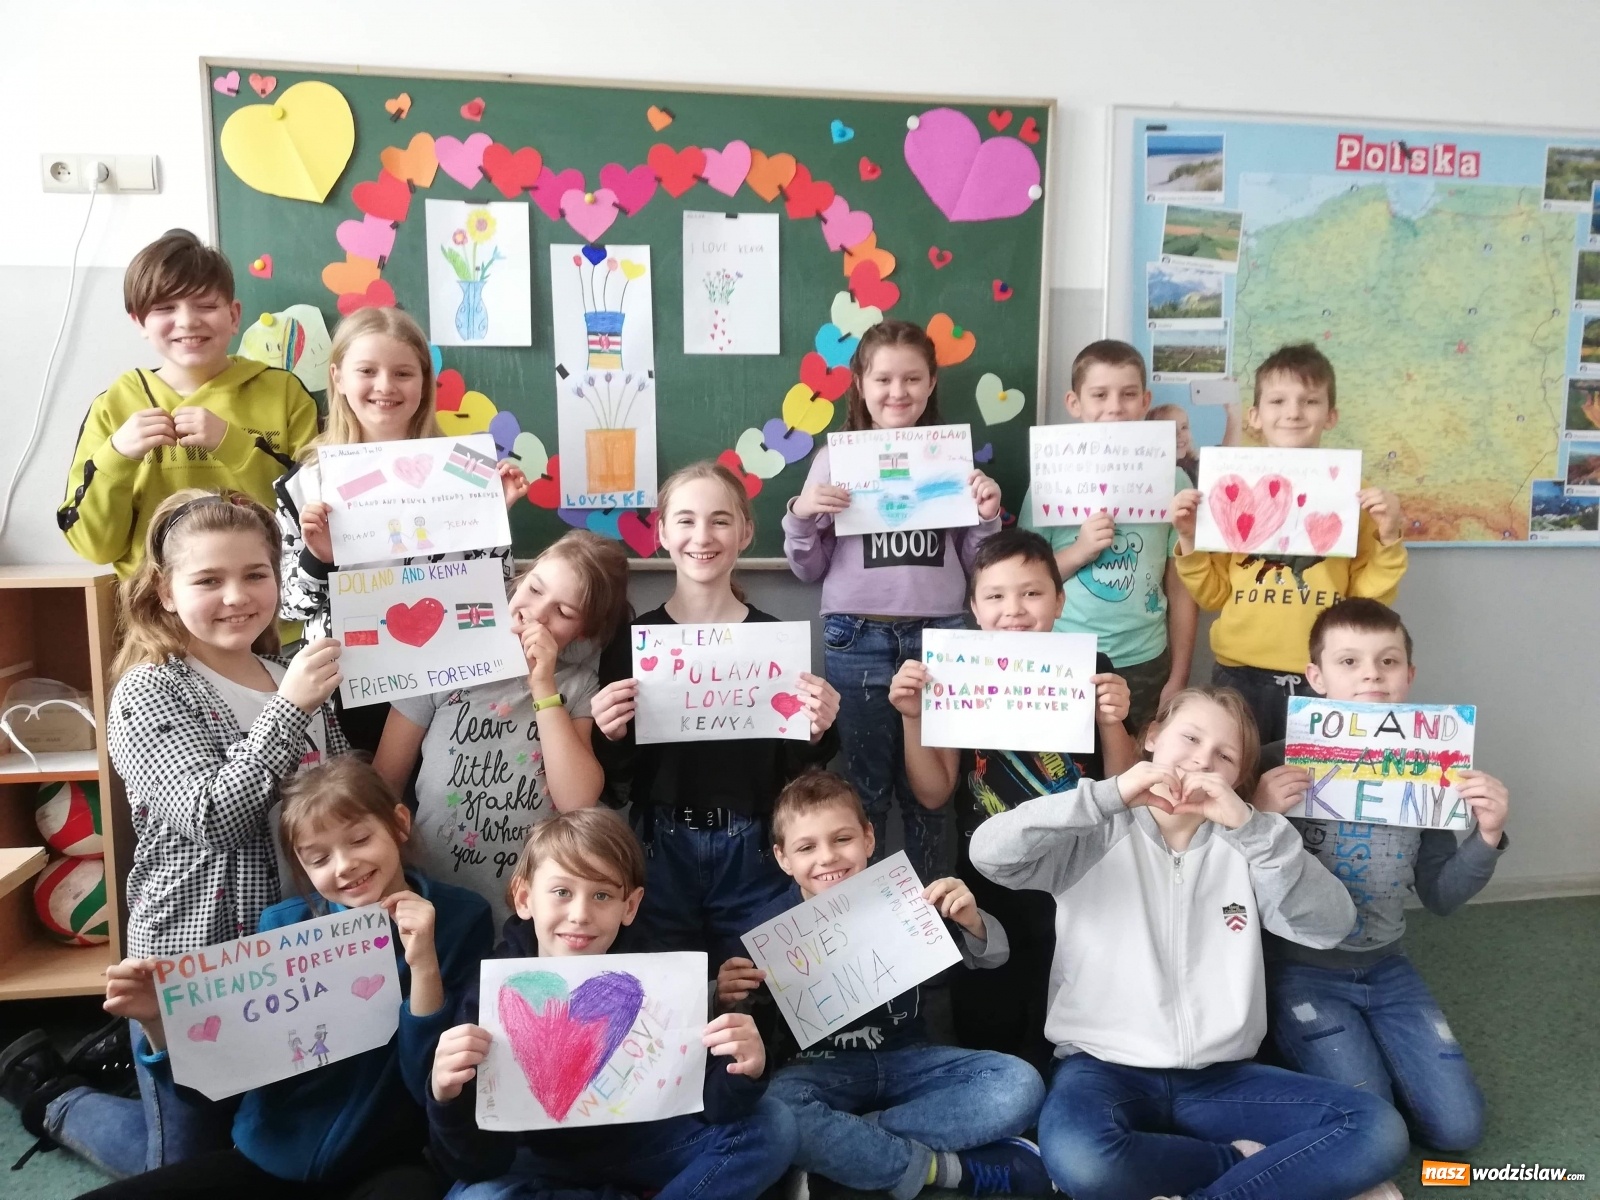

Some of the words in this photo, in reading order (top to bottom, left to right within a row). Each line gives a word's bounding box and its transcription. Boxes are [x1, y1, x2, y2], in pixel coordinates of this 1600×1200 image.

[1338, 137, 1478, 177] Polska
[739, 244, 764, 254] KENYA
[896, 431, 924, 441] FROM
[926, 429, 967, 441] POLAND
[1034, 441, 1101, 459] POLAND
[1103, 443, 1130, 456] AND
[343, 530, 376, 542] POLAND
[871, 530, 940, 559] MOOD
[338, 568, 394, 595] POLAND
[401, 567, 425, 585] AND
[428, 562, 468, 581] KENYA
[682, 627, 734, 646] LENA
[673, 658, 782, 684] POLAND
[926, 650, 994, 667] POLAND
[1013, 658, 1074, 679] KENYA
[685, 686, 760, 709] LOVES
[925, 682, 999, 697] POLAND
[1003, 684, 1032, 696] AND
[1037, 684, 1086, 700] KENYA
[925, 697, 992, 711] FRIENDS
[1006, 699, 1069, 712] FOREVER
[450, 701, 518, 745] leave
[680, 715, 755, 732] KENYA
[1309, 710, 1459, 742] POLAND
[447, 749, 514, 788] little
[1353, 747, 1430, 776] AND
[461, 775, 543, 831] sparkle
[1305, 765, 1470, 831] KENYA
[451, 844, 487, 873] you
[494, 851, 518, 878] go
[872, 875, 893, 899] FROM
[889, 898, 920, 937] POLAND
[889, 865, 943, 945] GREETINGS
[752, 893, 851, 960] POLAND
[155, 939, 271, 984] POLAND
[279, 928, 323, 950] AND
[330, 912, 387, 938] KENYA
[286, 941, 372, 977] FOREVER
[786, 948, 897, 1041] KENYA
